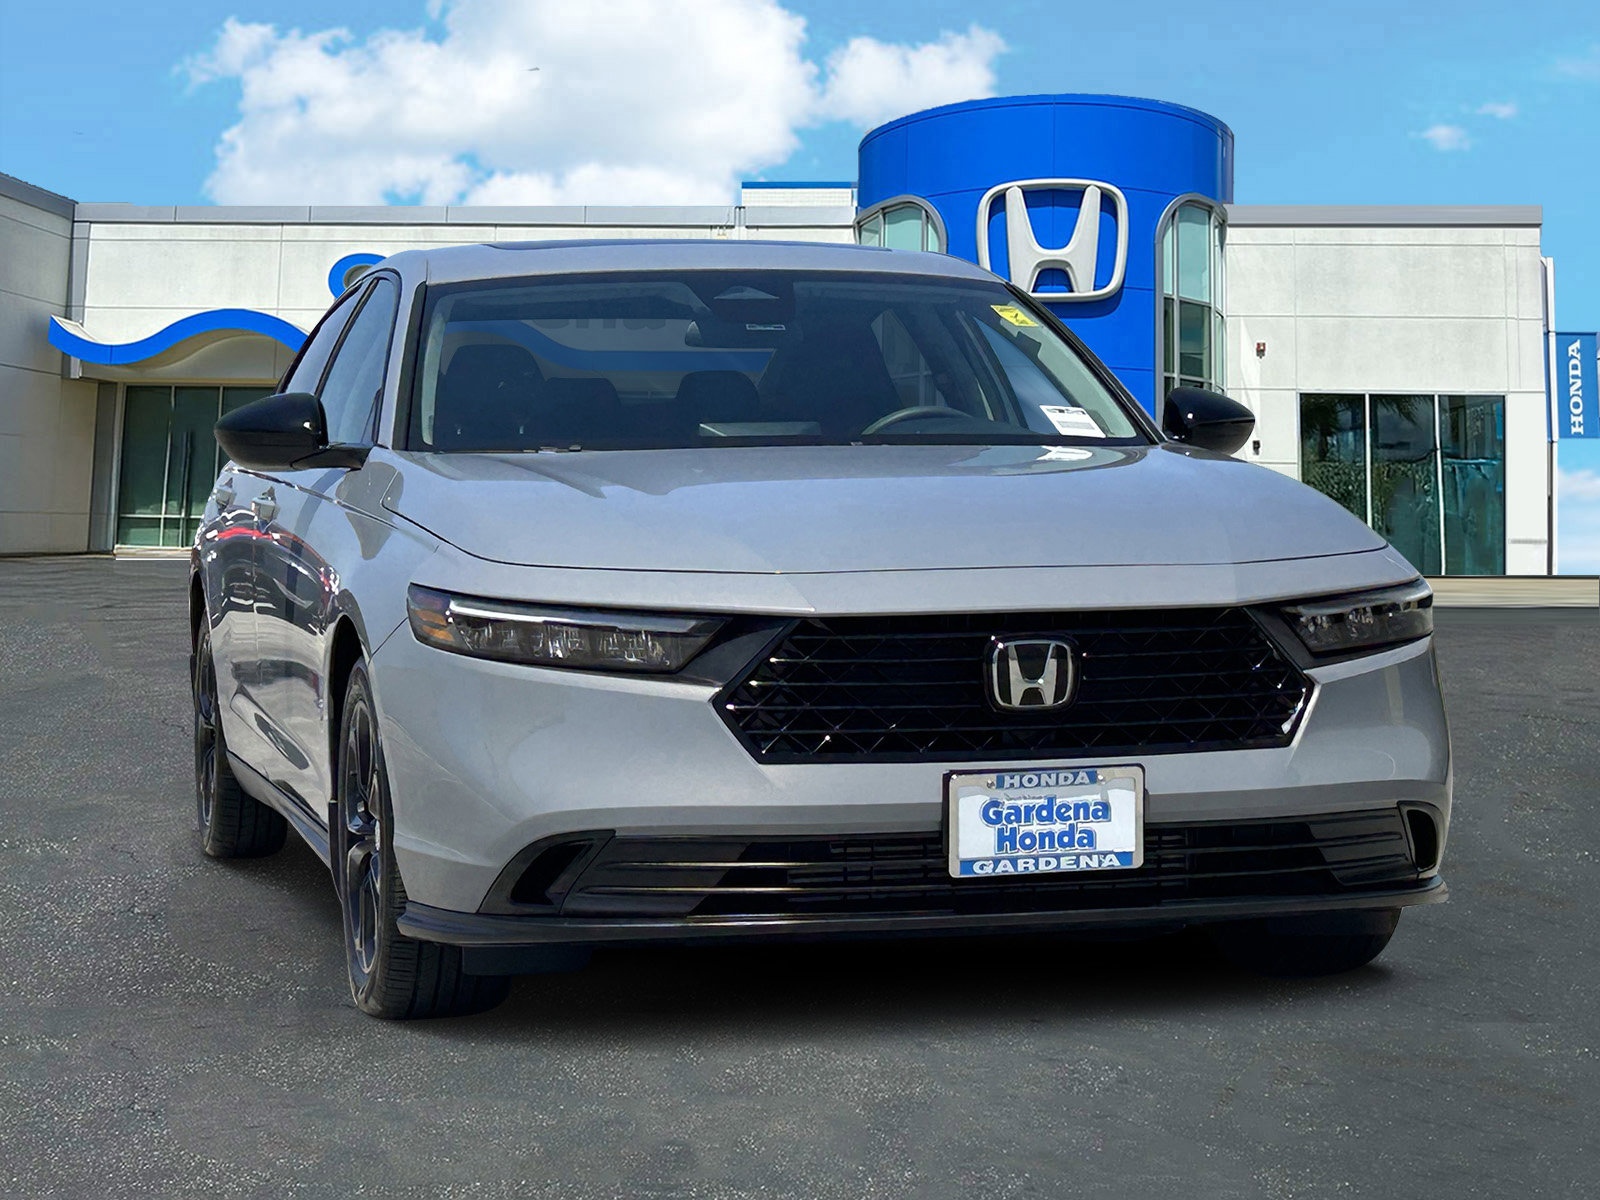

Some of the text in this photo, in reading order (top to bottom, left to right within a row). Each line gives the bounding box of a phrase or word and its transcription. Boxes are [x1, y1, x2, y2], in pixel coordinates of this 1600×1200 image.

[1568, 339, 1584, 435] HONDA
[1003, 771, 1091, 788] HONDA
[980, 796, 1111, 827] Gardena
[995, 824, 1097, 853] Honda
[972, 853, 1121, 875] GARDENA
